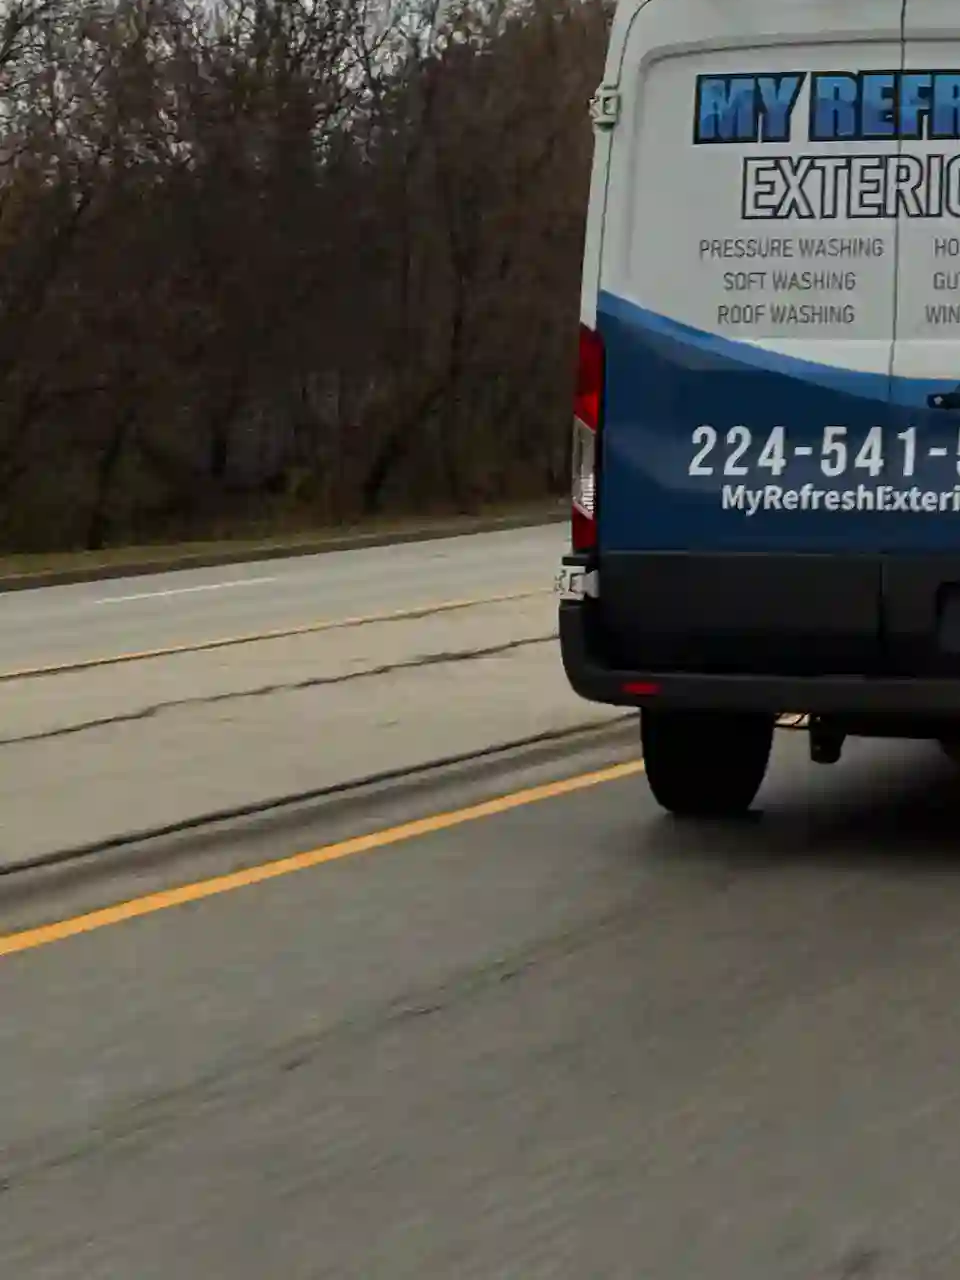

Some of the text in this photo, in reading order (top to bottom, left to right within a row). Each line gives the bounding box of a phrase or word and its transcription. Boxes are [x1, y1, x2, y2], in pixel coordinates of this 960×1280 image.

[693, 72, 807, 144] MY
[700, 238, 884, 259] PRESSURE WASHING
[723, 272, 856, 291] SOFT WASHING
[717, 305, 855, 325] ROOF WASHING
